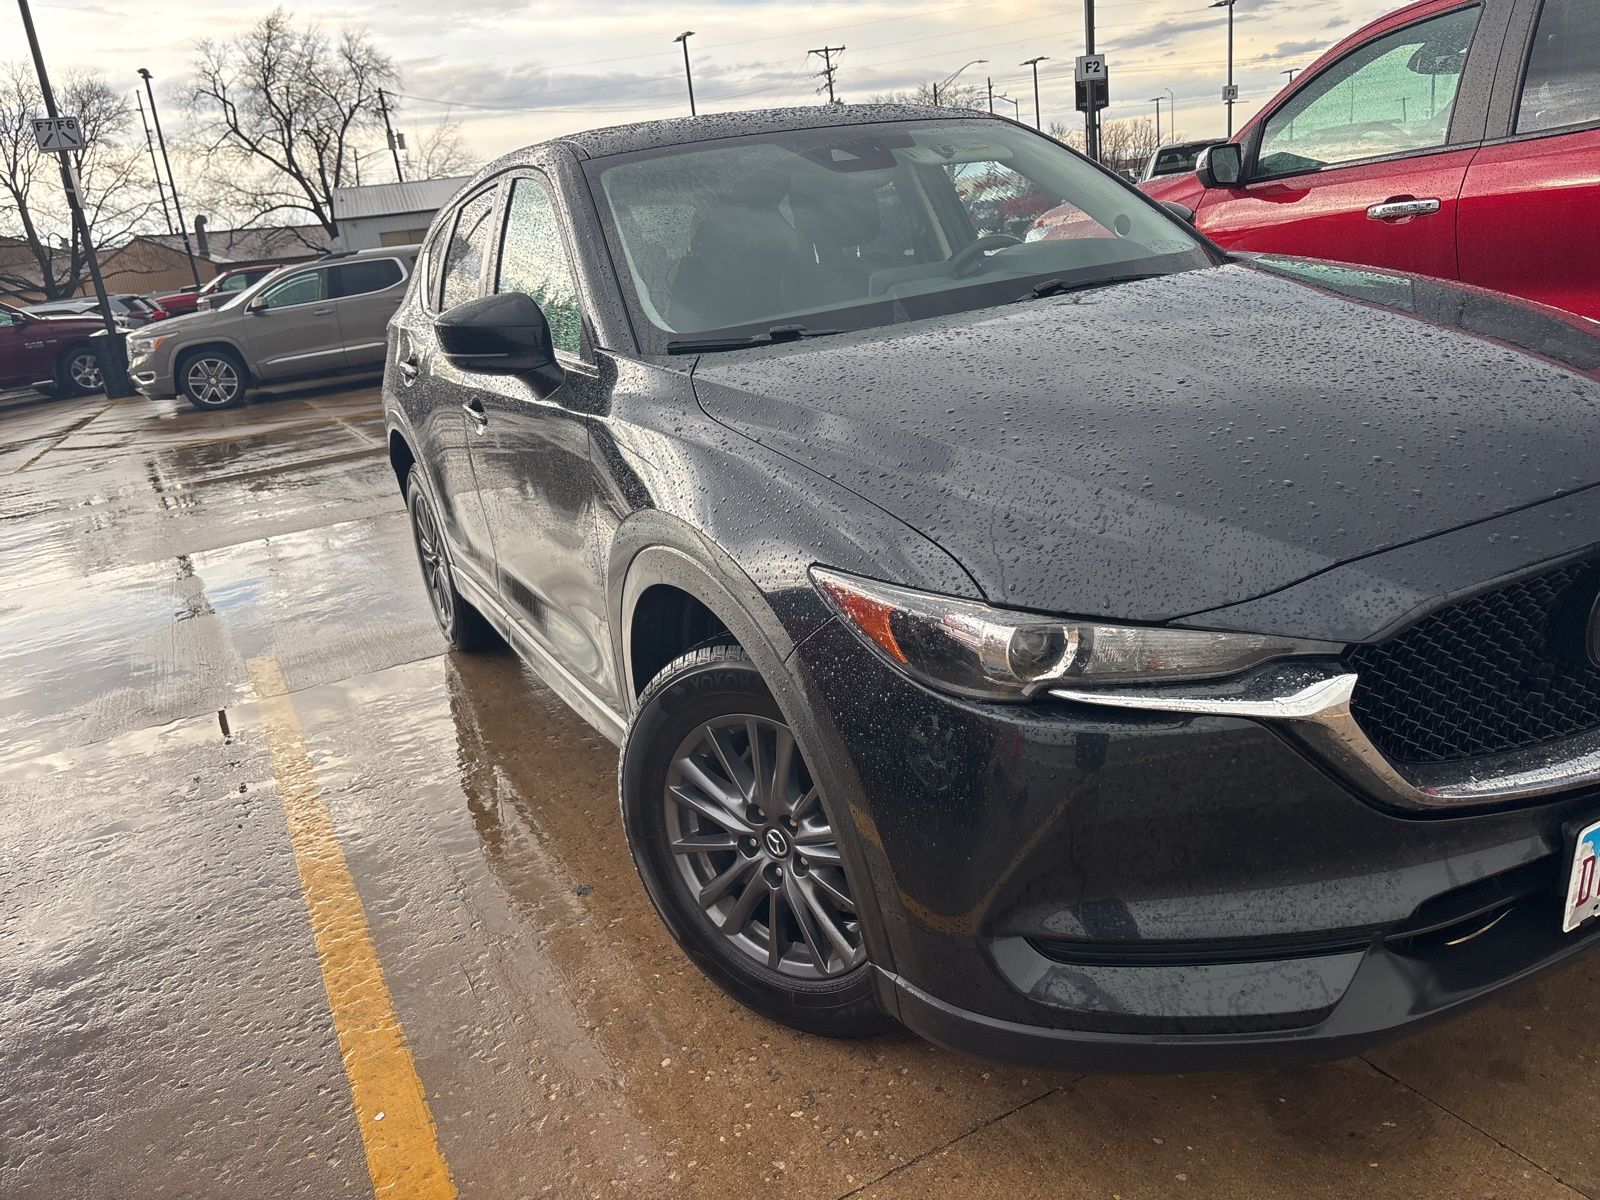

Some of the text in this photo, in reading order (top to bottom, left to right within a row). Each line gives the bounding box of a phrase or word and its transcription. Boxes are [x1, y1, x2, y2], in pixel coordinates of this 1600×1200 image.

[1085, 61, 1100, 73] F2
[35, 121, 53, 132] F7
[56, 120, 75, 130] F6
[1576, 855, 1600, 908] D
